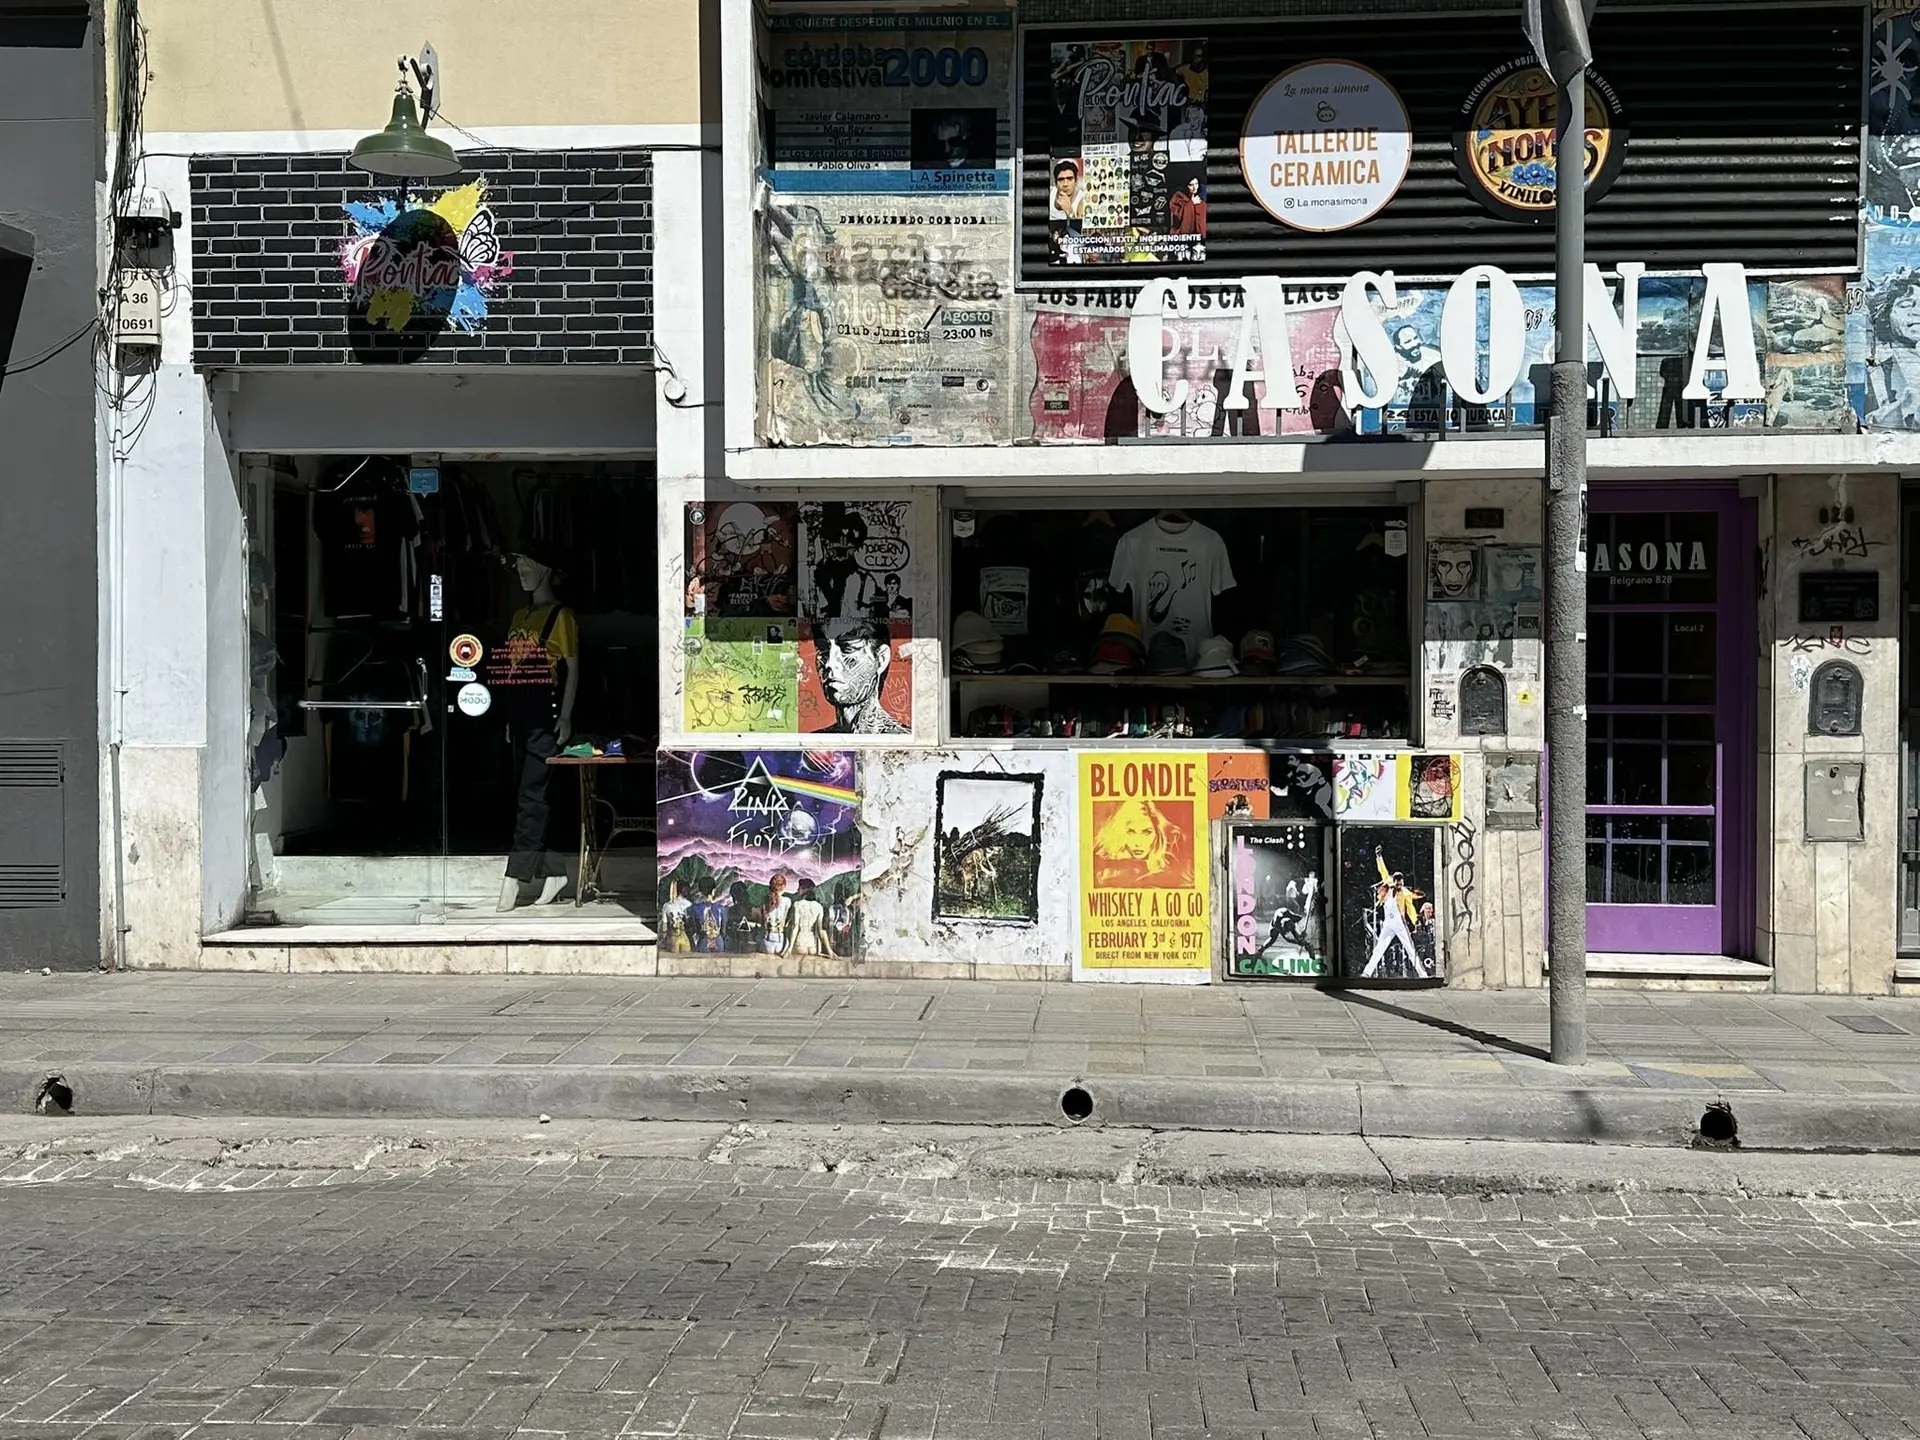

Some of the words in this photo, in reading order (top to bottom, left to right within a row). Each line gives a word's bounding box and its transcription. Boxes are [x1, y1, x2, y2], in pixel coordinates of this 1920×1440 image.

[795, 16, 837, 28] QUIERE
[839, 16, 895, 28] DESPEDIR
[898, 15, 911, 27] EL
[915, 14, 964, 27] MILENIO
[967, 14, 982, 26] EN
[883, 47, 988, 87] 2000
[1075, 57, 1187, 119] Pontiac
[1300, 85, 1329, 96] mona
[1333, 83, 1370, 95] simona
[1460, 61, 1507, 116] COLECCIONISMO
[1507, 59, 1513, 69] Y
[1595, 77, 1624, 117] RECIENTES
[804, 112, 831, 121] Javier
[834, 112, 881, 121] Calamaro
[1487, 95, 1557, 129] AYE
[1274, 128, 1349, 154] TALLER
[1353, 127, 1379, 152] DE
[1487, 129, 1603, 175] NOMS
[817, 161, 844, 170] Pablo
[846, 161, 871, 169] Oliva
[934, 171, 995, 185] Spinetta
[1270, 159, 1380, 188] CERAMICA
[839, 215, 924, 225] DEMOLIENDO
[1112, 235, 1138, 243] TEXTIL
[1139, 233, 1202, 243] INDEPENDIENTE
[1073, 245, 1125, 254] ESTAMPADOS
[352, 237, 460, 299] Pontiac
[132, 293, 148, 304] 36
[1037, 287, 1077, 306] LOS
[943, 311, 991, 324] Agosto
[837, 324, 870, 336] Club
[873, 325, 931, 339] Juniors
[943, 328, 976, 340] 23:00
[980, 327, 993, 338] hs
[1129, 262, 1765, 414] CASONA
[1387, 409, 1411, 419] 24
[1414, 408, 1460, 422] ESTAIO
[1466, 408, 1514, 422] URACA
[864, 555, 900, 568] CLIX
[1592, 540, 1708, 572] ASONA
[1609, 575, 1653, 588] Belgrano
[1674, 624, 1698, 633] Local
[1699, 624, 1705, 632] 2
[1090, 762, 1196, 797] BLONDIE
[731, 786, 788, 827] PINK
[726, 818, 797, 859] FLOYD
[1249, 836, 1263, 844] The
[1264, 836, 1285, 844] Clash
[1236, 835, 1257, 955] LONDON
[1088, 892, 1143, 917] WHISKEY
[1151, 892, 1160, 917] A
[1166, 892, 1181, 917] GO
[1188, 892, 1203, 917] GO
[1101, 919, 1114, 928] LOS
[1151, 919, 1190, 927] CALIFORNIA
[1088, 931, 1147, 949] FEBRUARY
[1181, 931, 1204, 948] 1977
[1096, 951, 1119, 960] DIRECT
[1122, 951, 1141, 959] FROM
[1144, 951, 1159, 959] NEW
[1163, 951, 1179, 959] YORK
[1182, 950, 1197, 960] CITY
[1239, 958, 1328, 974] CALLING
